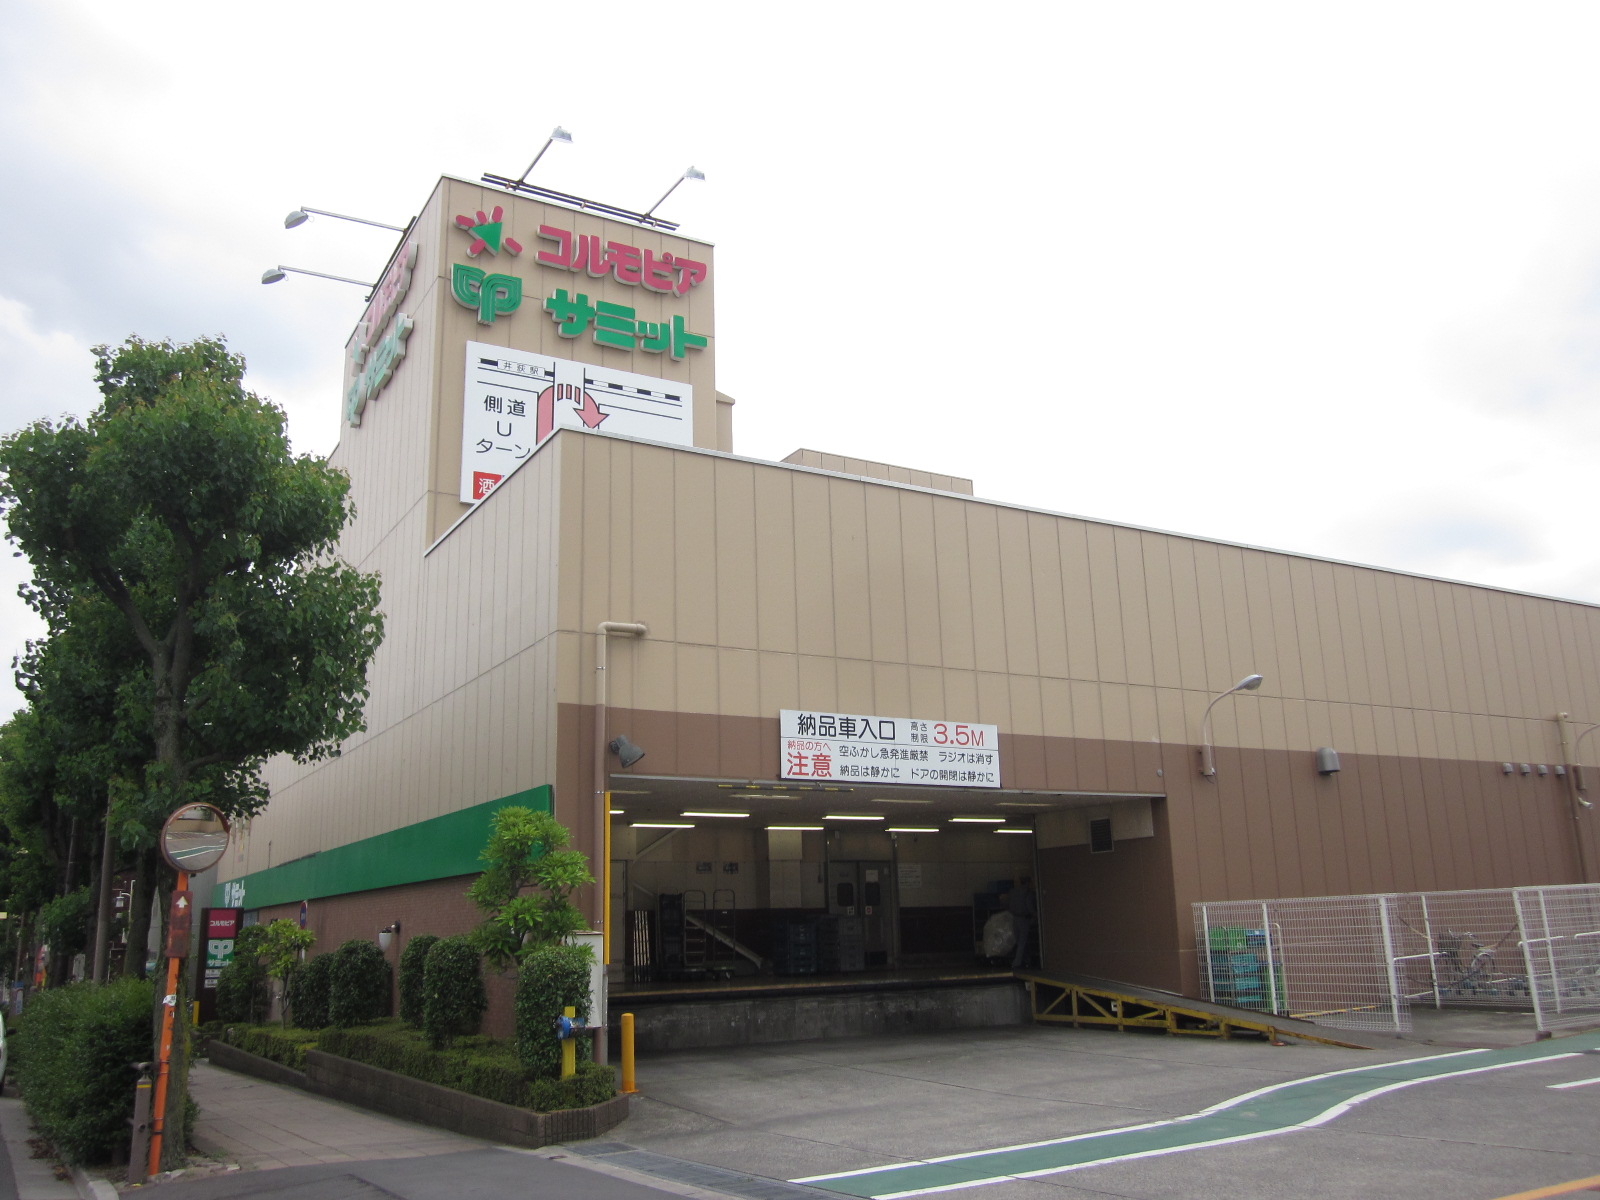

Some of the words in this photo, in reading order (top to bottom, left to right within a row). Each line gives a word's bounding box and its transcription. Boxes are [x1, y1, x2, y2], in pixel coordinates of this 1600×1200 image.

[535, 224, 707, 297] コルモピア
[543, 288, 708, 361] サミット
[483, 394, 526, 418] 側道
[497, 421, 512, 437] U
[476, 438, 531, 459] ターン
[797, 713, 896, 740] 納品車入口
[910, 721, 928, 732] 高さ
[933, 723, 984, 746] 3.5M
[787, 740, 832, 752] 納品の方へ
[910, 733, 929, 744] 制限
[787, 751, 832, 778] 注意
[839, 745, 929, 762] 空ふかし急発進厳禁
[938, 751, 994, 765] ラジオは消す
[840, 764, 900, 779] 納品は静かに
[911, 767, 995, 783] ドアの開閉は静かに
